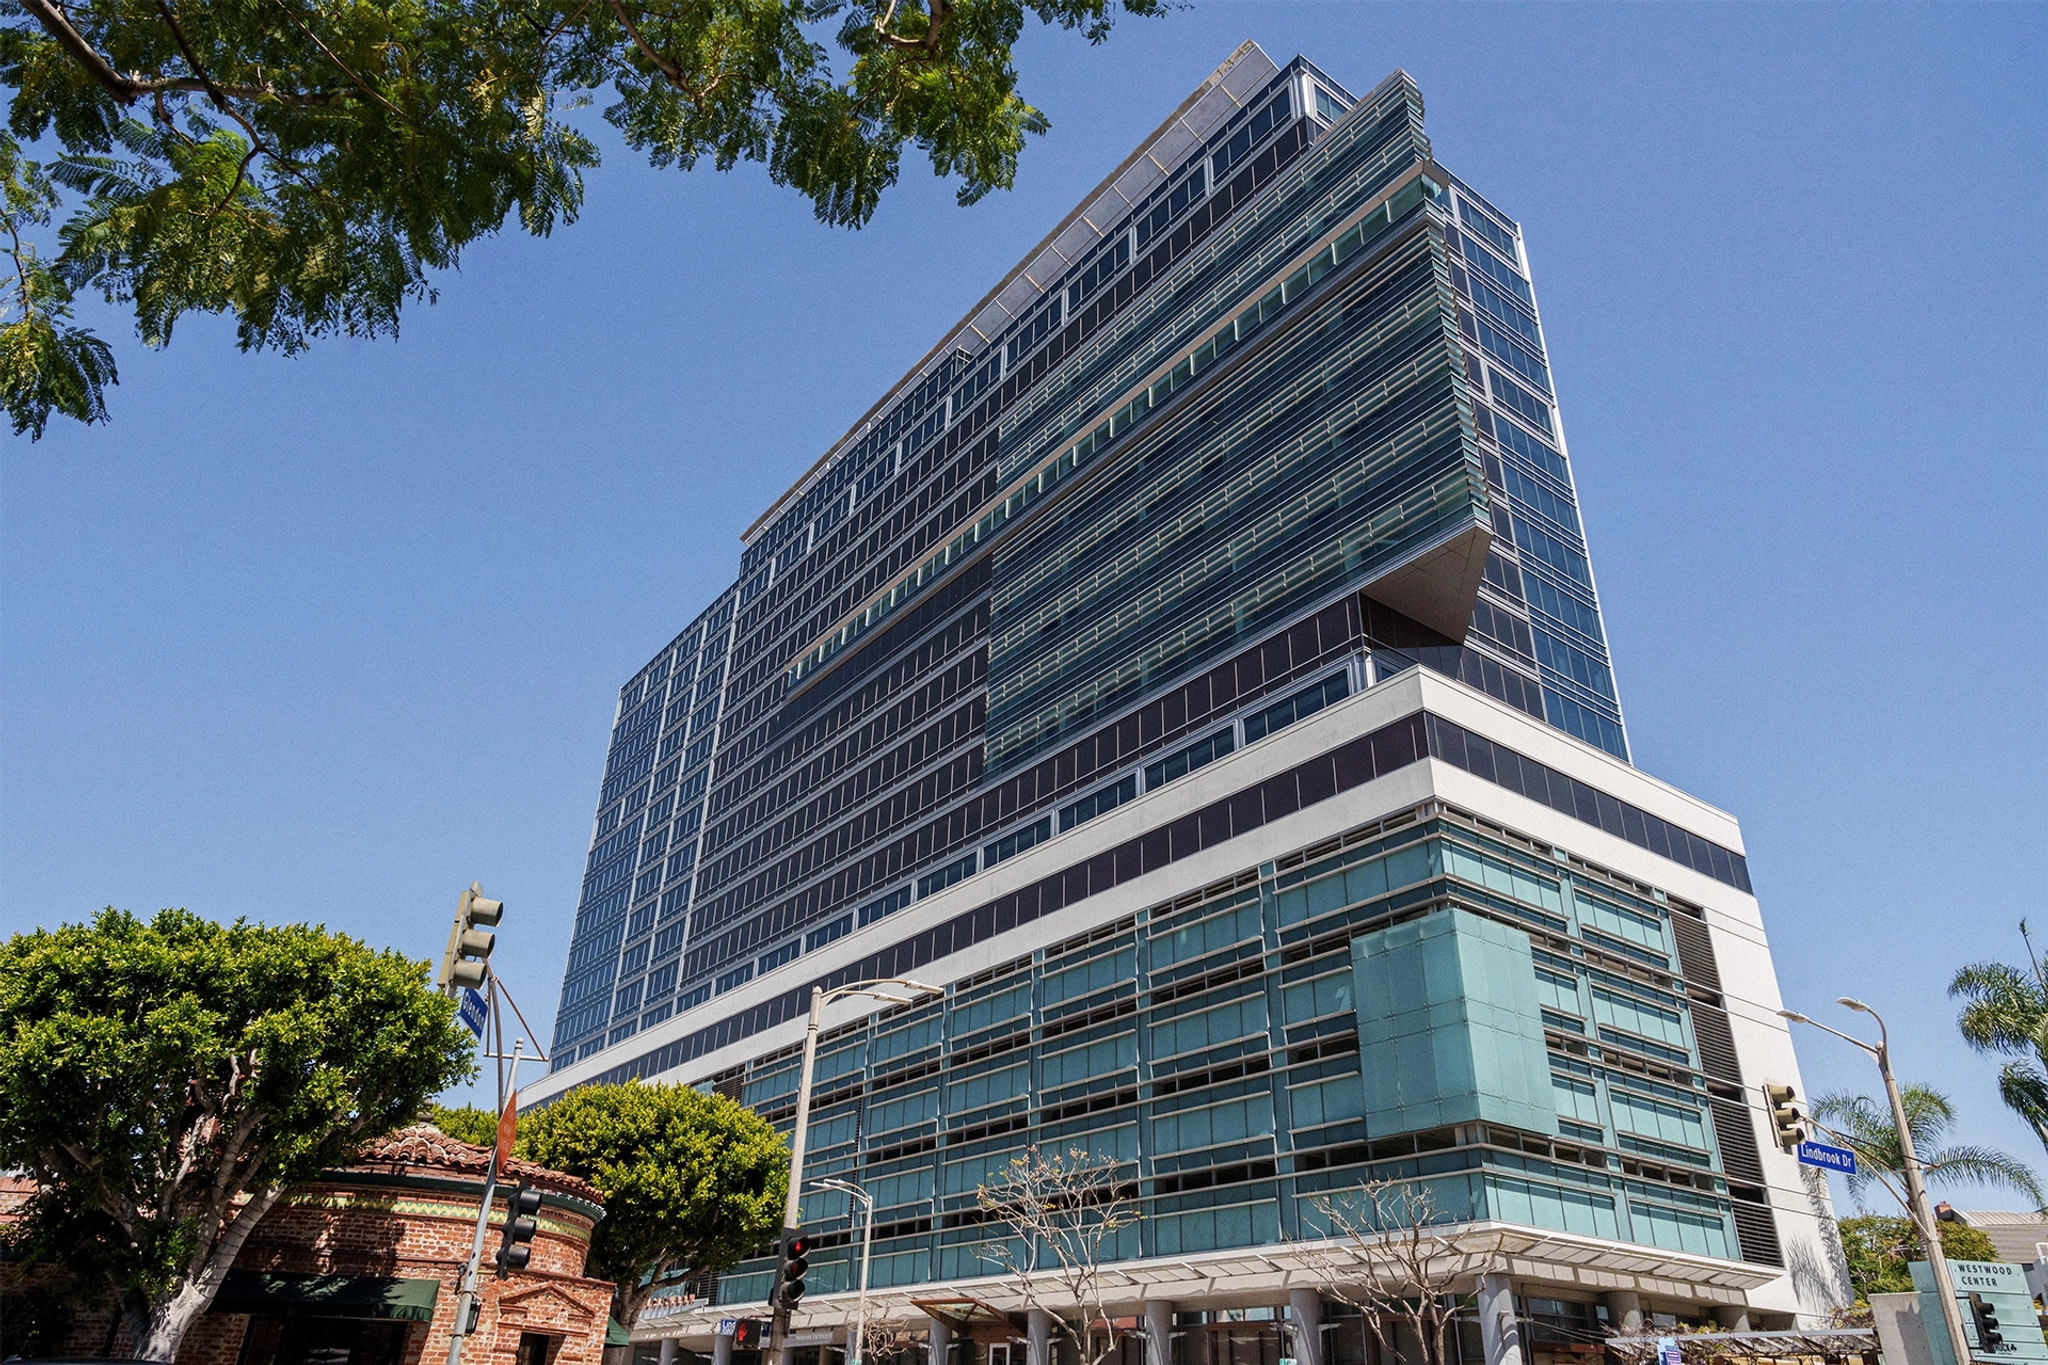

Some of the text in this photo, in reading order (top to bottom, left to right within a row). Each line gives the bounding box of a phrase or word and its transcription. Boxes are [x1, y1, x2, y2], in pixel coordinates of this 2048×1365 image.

[463, 991, 485, 1030] Glendon
[1801, 1144, 1851, 1167] Lindbrook Dr
[1958, 1264, 2012, 1275] WESTWOOD
[1961, 1276, 1998, 1286] CENTER
